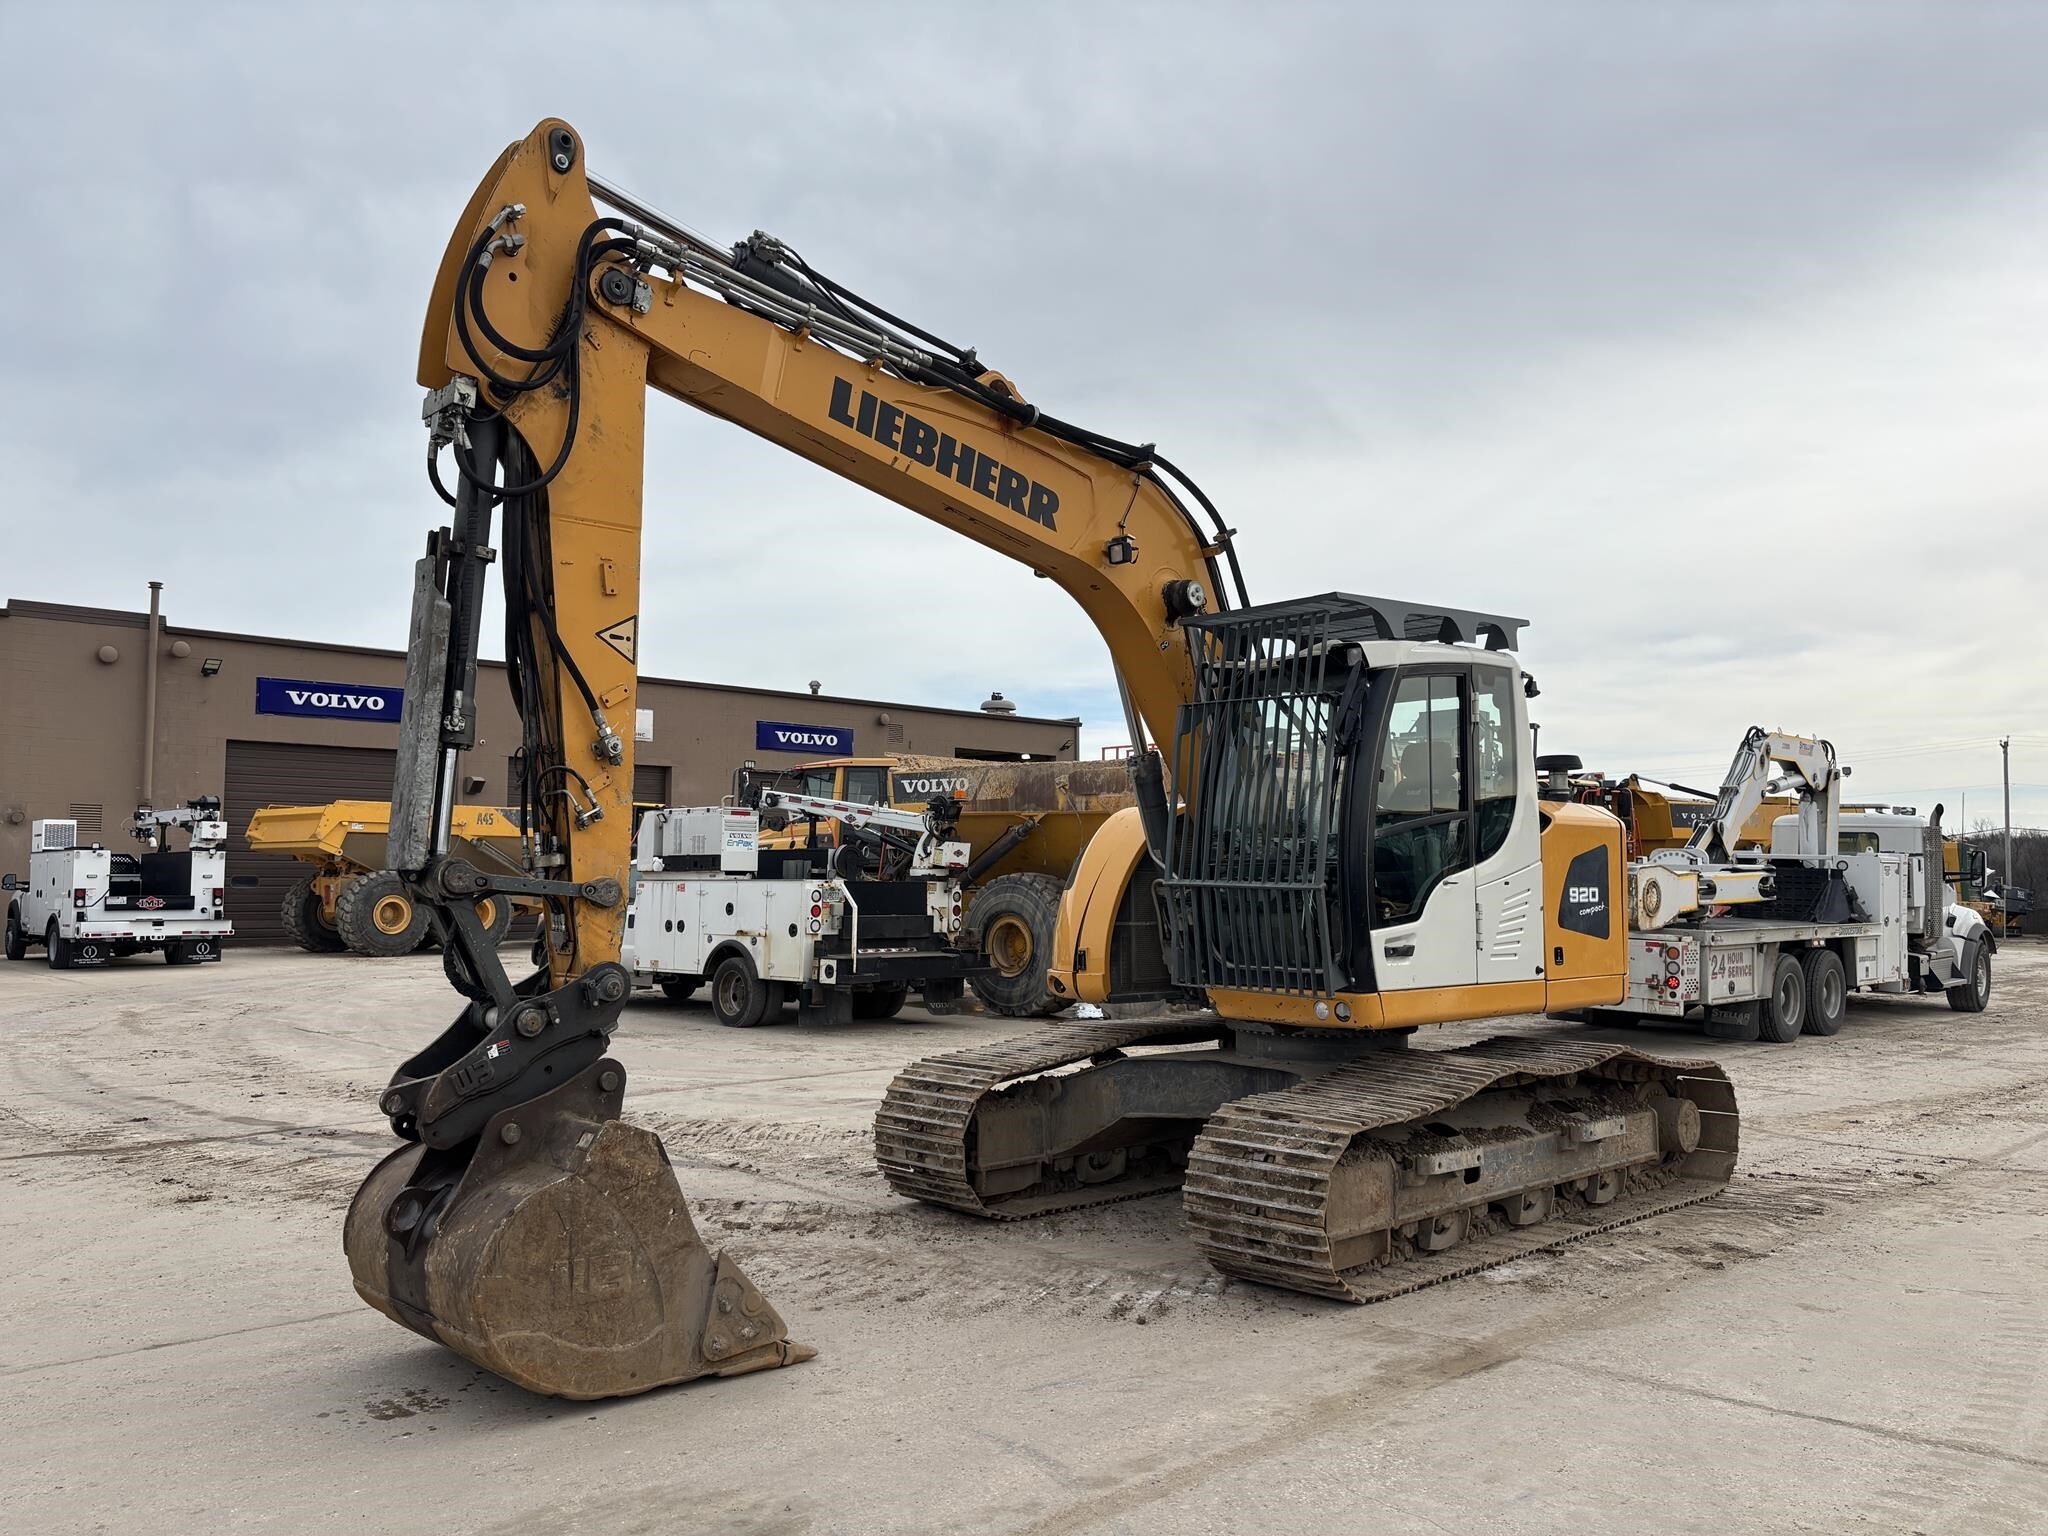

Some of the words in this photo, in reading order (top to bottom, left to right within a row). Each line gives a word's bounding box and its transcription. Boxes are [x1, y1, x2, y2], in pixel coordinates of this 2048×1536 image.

[828, 376, 1060, 533] LIEBHERR
[285, 690, 385, 711] VOLVO
[775, 731, 838, 746] VOLVO
[901, 777, 969, 794] VOLVO
[476, 813, 494, 826] A45
[1569, 887, 1599, 903] 920
[1579, 901, 1608, 916] compact
[1711, 954, 1726, 978] 24
[1727, 952, 1744, 965] HOUR
[1727, 965, 1753, 979] SERVICE
[1711, 1008, 1751, 1021] STELLAR
